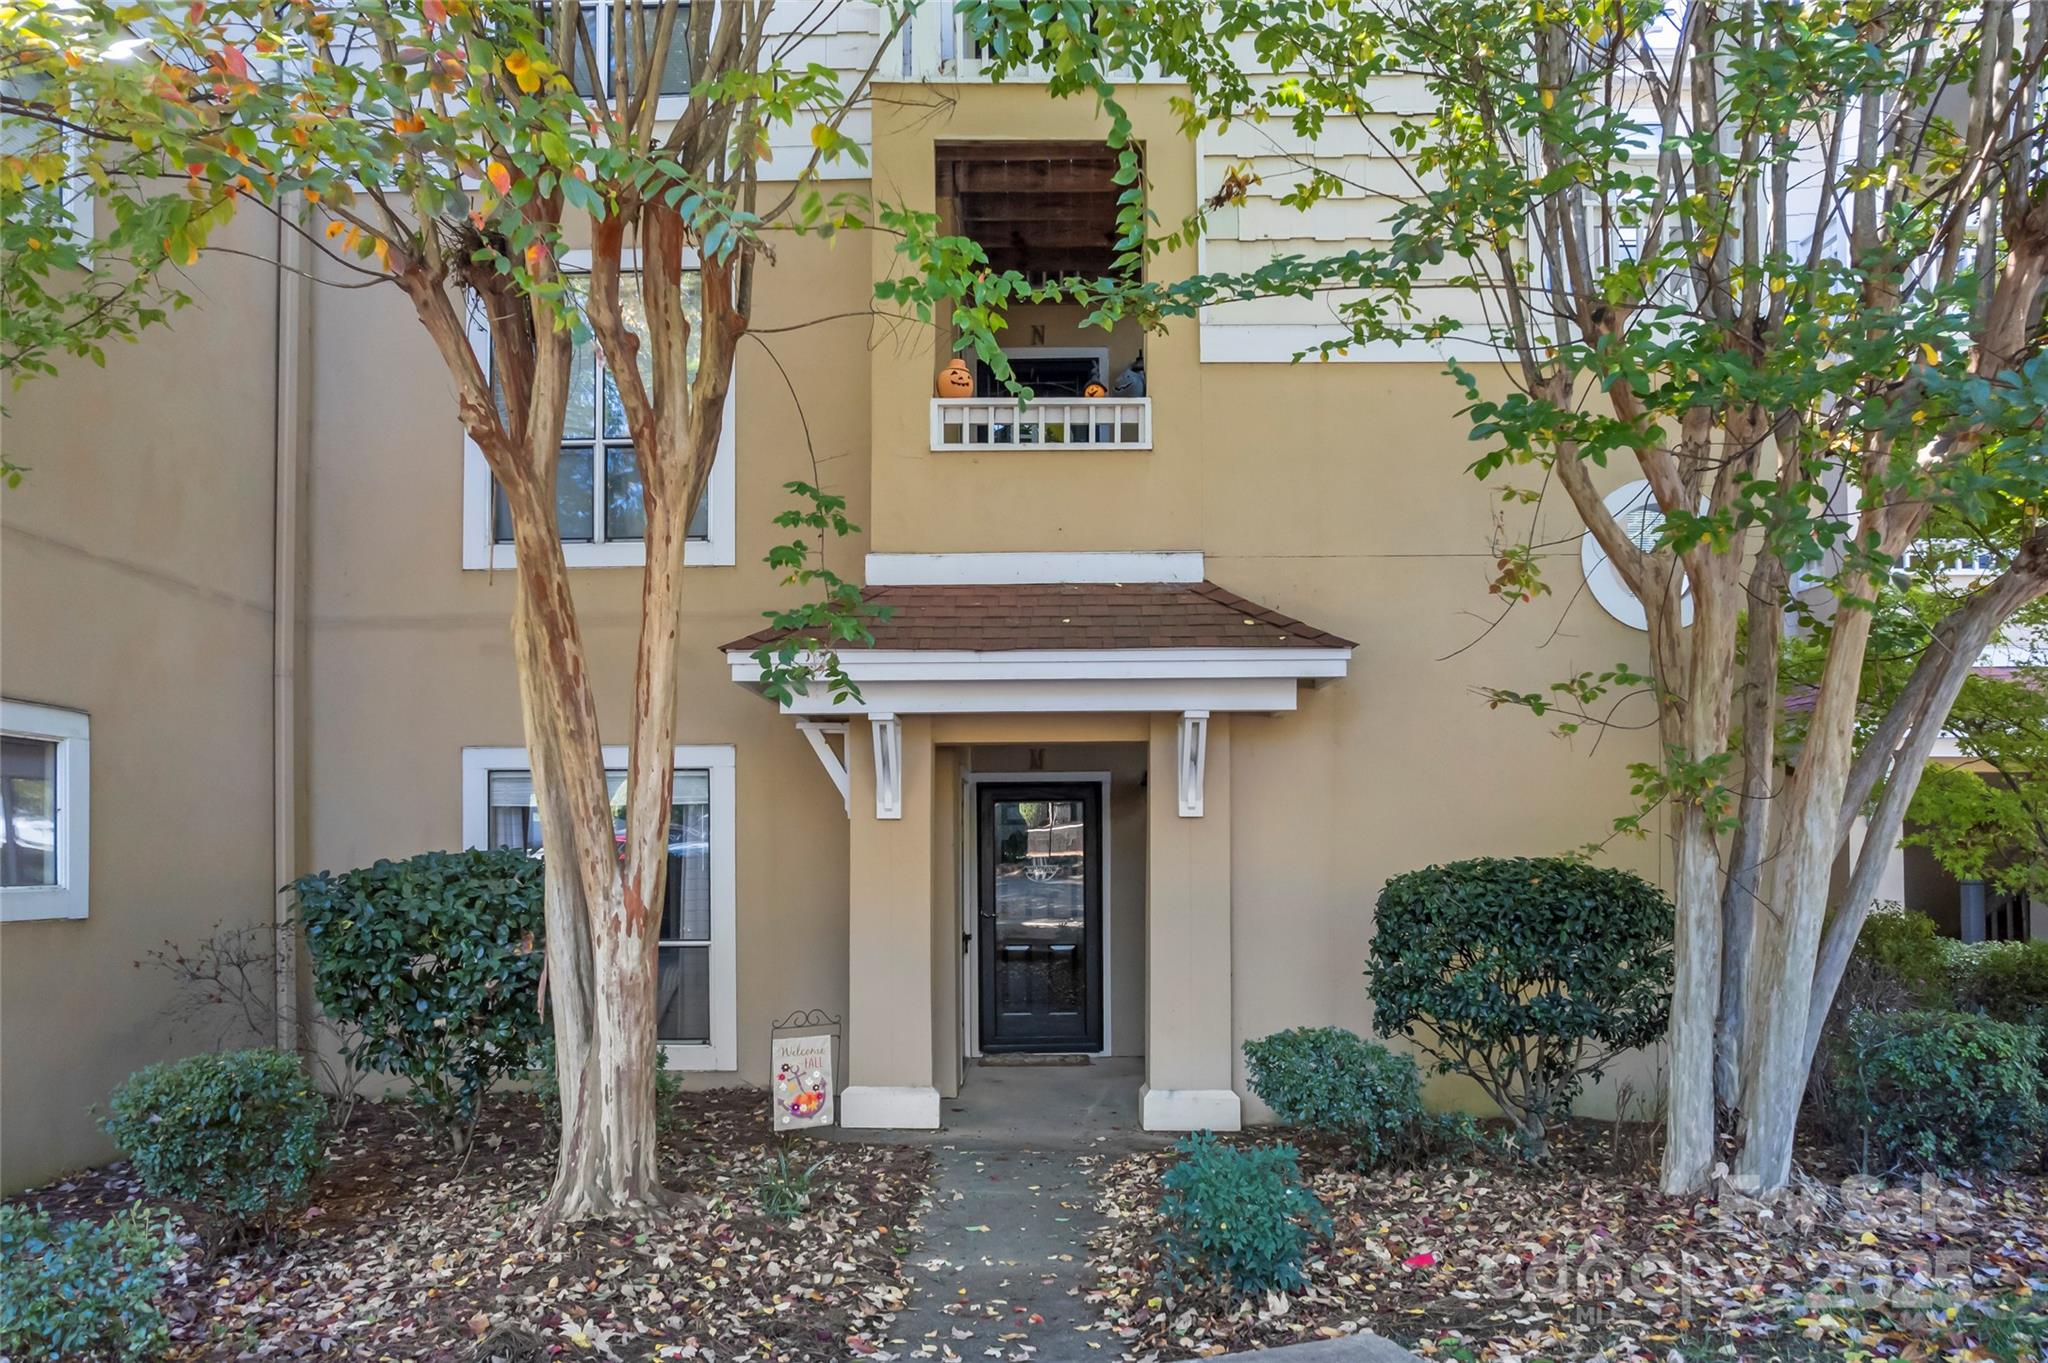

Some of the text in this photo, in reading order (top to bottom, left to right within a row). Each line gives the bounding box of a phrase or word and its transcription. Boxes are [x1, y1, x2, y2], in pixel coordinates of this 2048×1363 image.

[1030, 324, 1046, 346] N
[1029, 747, 1046, 770] N
[781, 1046, 826, 1057] Welcome
